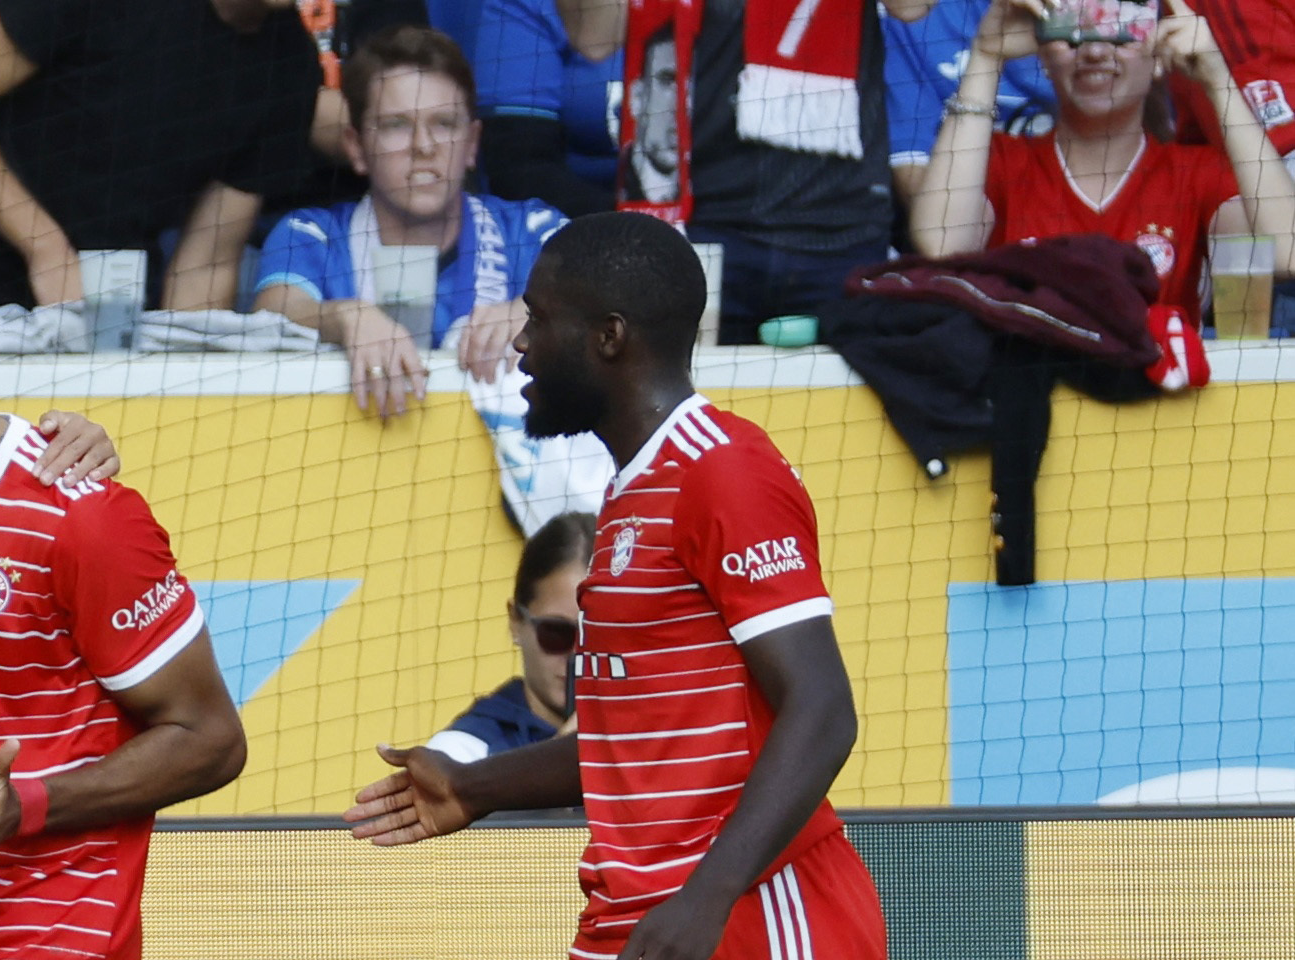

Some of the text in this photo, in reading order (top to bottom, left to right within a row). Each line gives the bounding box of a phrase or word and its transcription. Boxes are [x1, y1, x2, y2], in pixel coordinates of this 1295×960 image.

[722, 536, 801, 576] QATAR
[750, 557, 806, 583] AIRWAYS
[111, 569, 176, 630] QATAR
[139, 581, 185, 631] AIRWAYS
